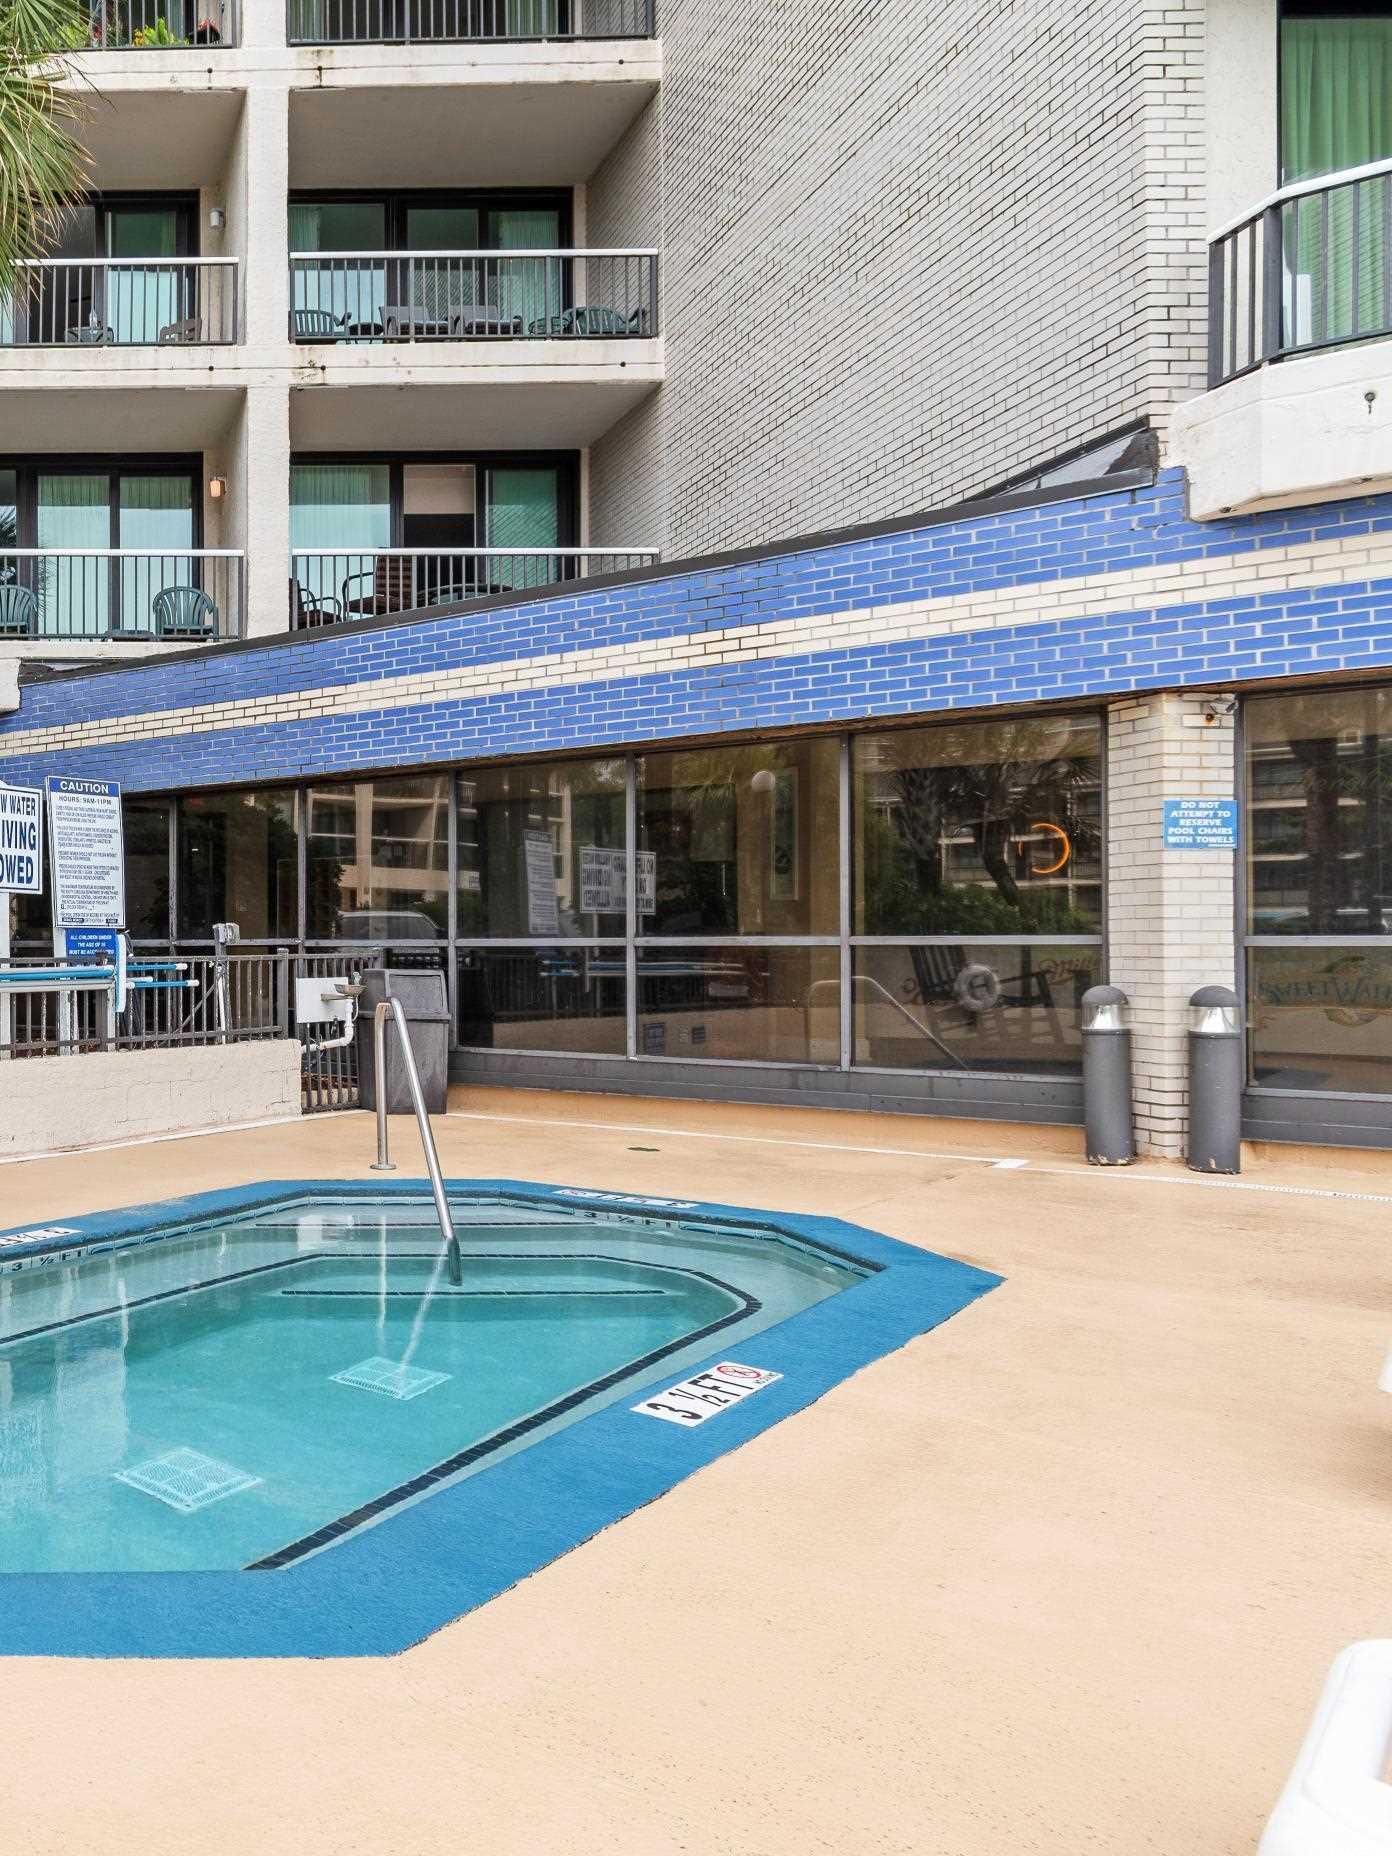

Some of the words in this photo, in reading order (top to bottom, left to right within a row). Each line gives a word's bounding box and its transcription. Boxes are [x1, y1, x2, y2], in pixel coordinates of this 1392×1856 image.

[60, 781, 109, 794] CAUTION
[9, 795, 36, 816] WATER
[1180, 801, 1196, 809] DO
[1198, 801, 1220, 809] NOT
[1169, 810, 1214, 818] ATTEMPT
[1216, 810, 1232, 818] TO
[1179, 818, 1222, 826] RESERVE
[1167, 827, 1195, 835] POOL
[1197, 827, 1233, 835] CHAIRS
[12, 1262, 23, 1271] 3
[646, 1402, 703, 1420] 3
[688, 1374, 754, 1397] FT
